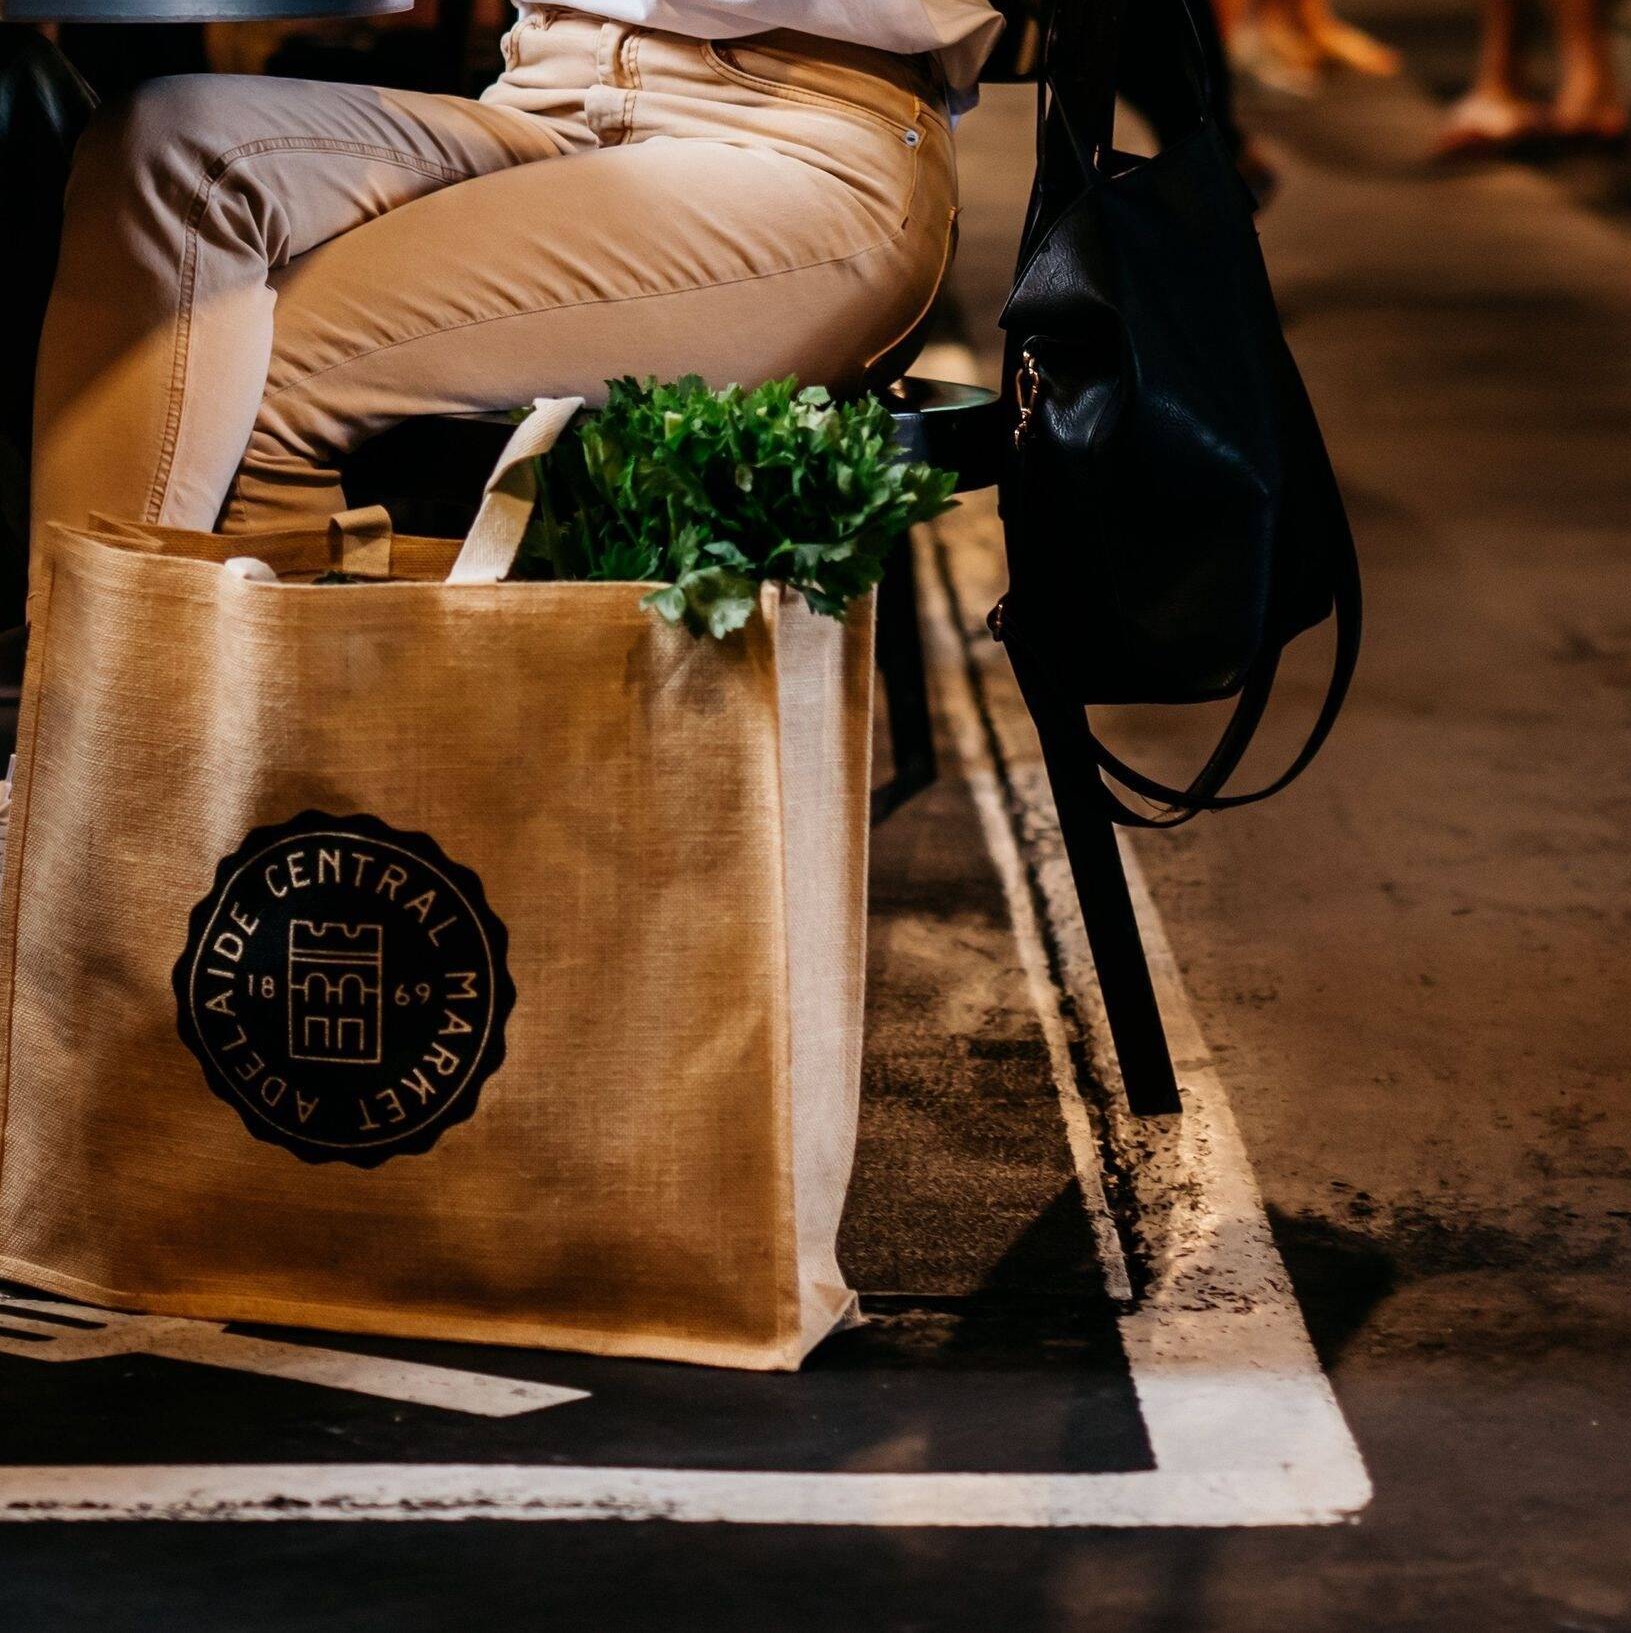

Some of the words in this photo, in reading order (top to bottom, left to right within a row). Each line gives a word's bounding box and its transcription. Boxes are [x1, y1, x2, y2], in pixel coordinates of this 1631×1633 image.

[264, 849, 458, 949] CENTRAL
[204, 901, 320, 1125] ADELAIDE
[246, 972, 275, 1000] 18
[394, 983, 431, 1007] 69
[358, 971, 479, 1132] MARKET
